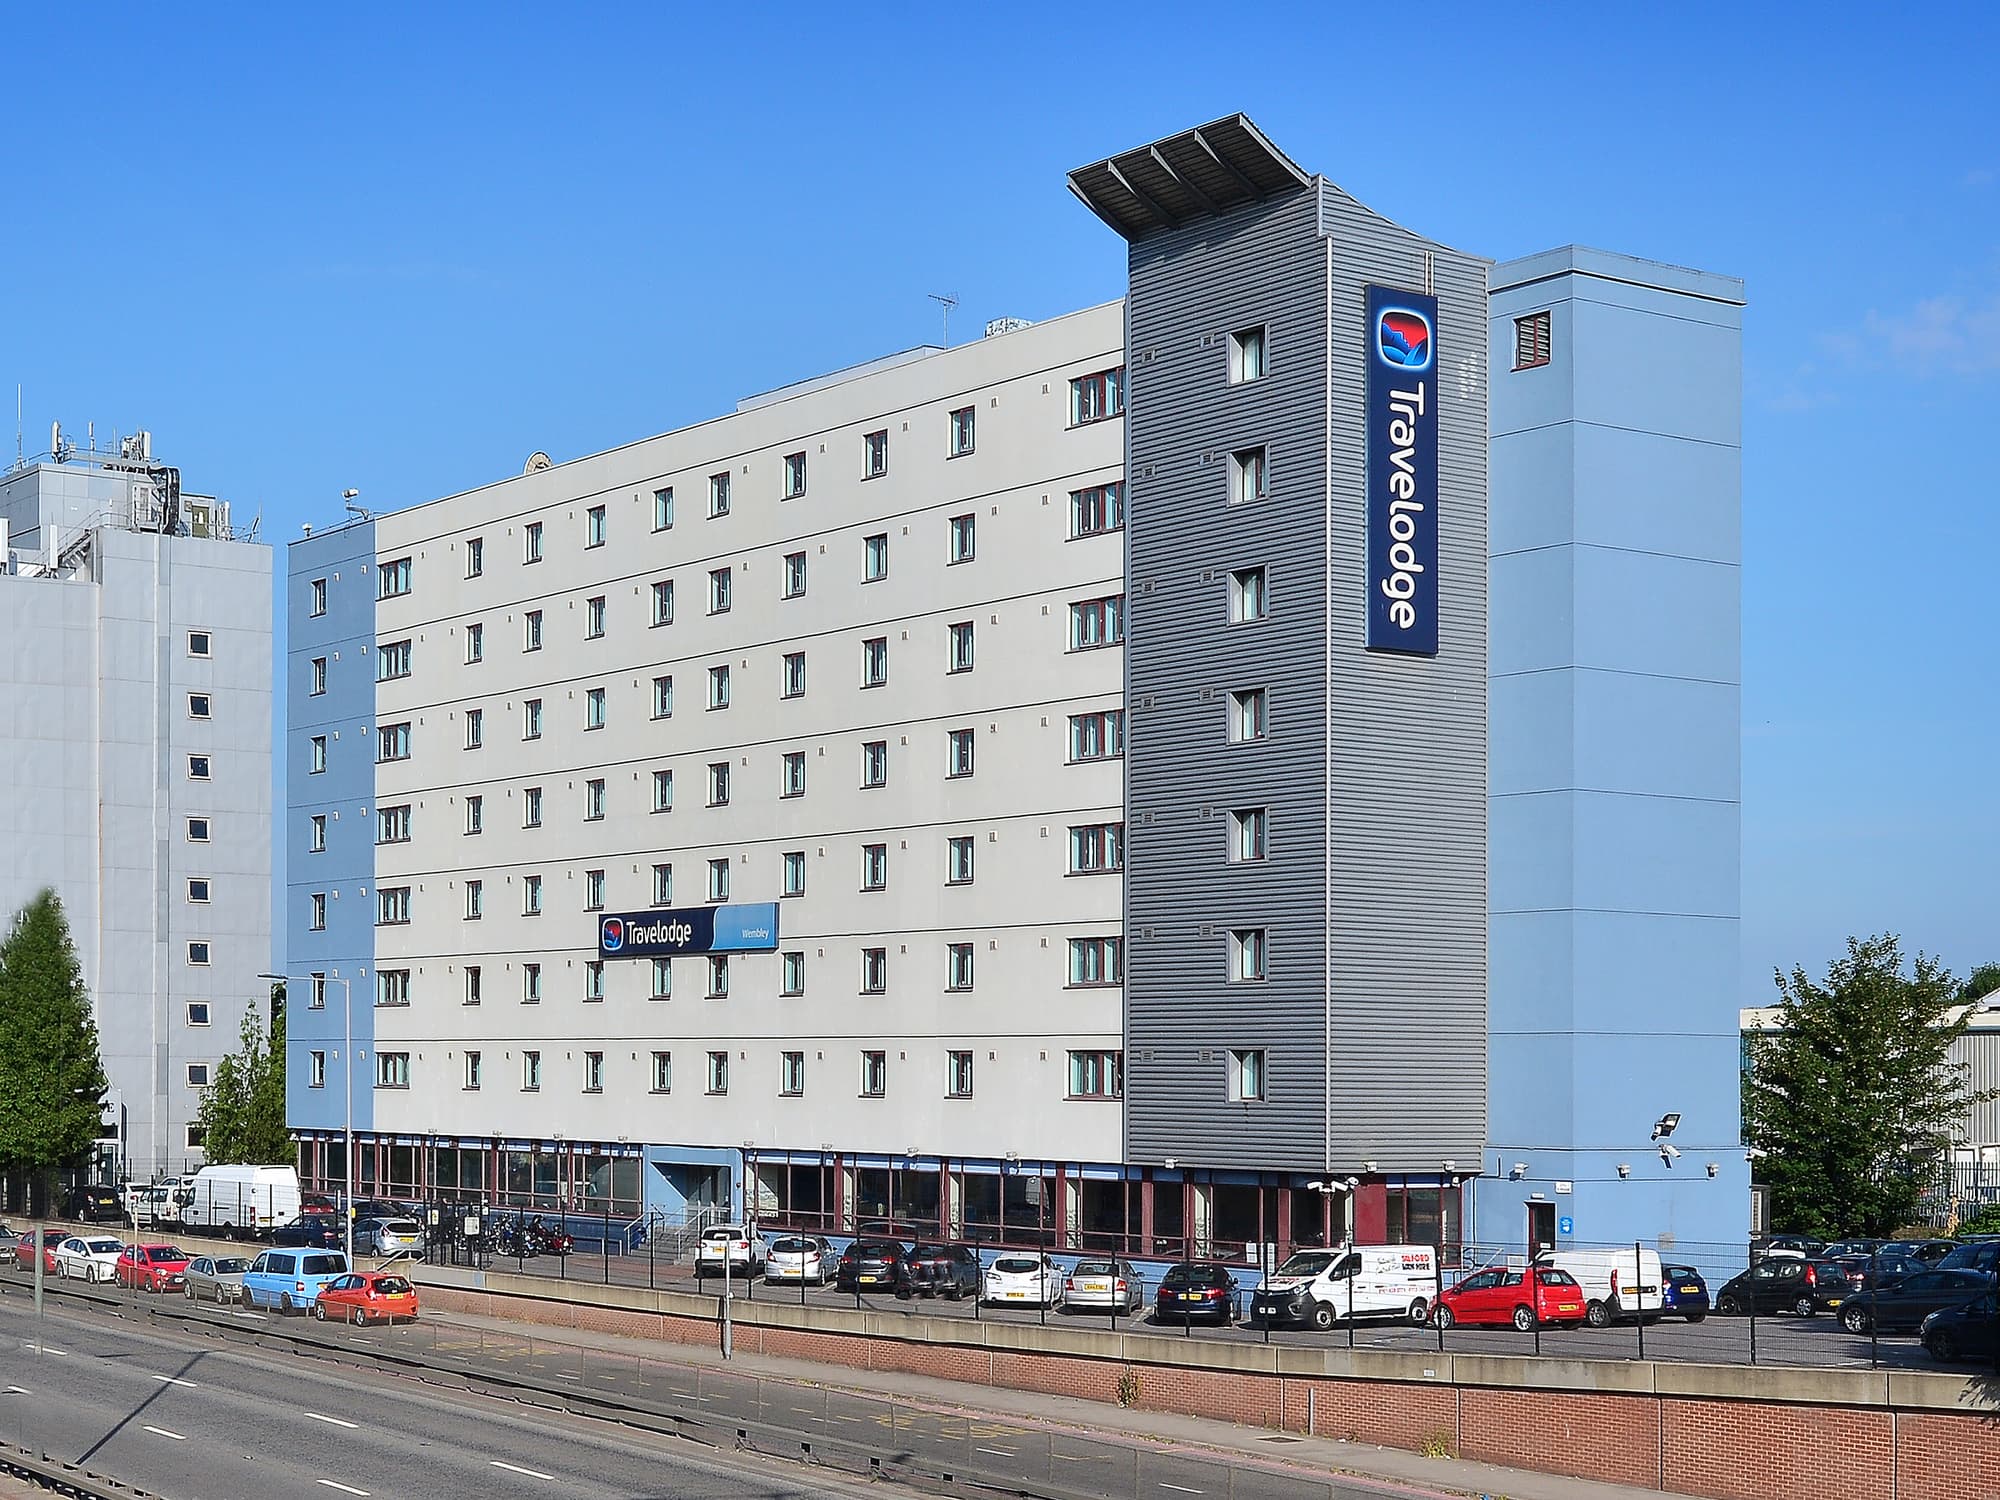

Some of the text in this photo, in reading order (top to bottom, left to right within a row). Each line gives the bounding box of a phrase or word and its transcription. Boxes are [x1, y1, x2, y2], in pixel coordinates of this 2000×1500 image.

[1381, 381, 1424, 630] Travelodge
[626, 918, 692, 948] Travelodge
[742, 928, 769, 941] Wembley
